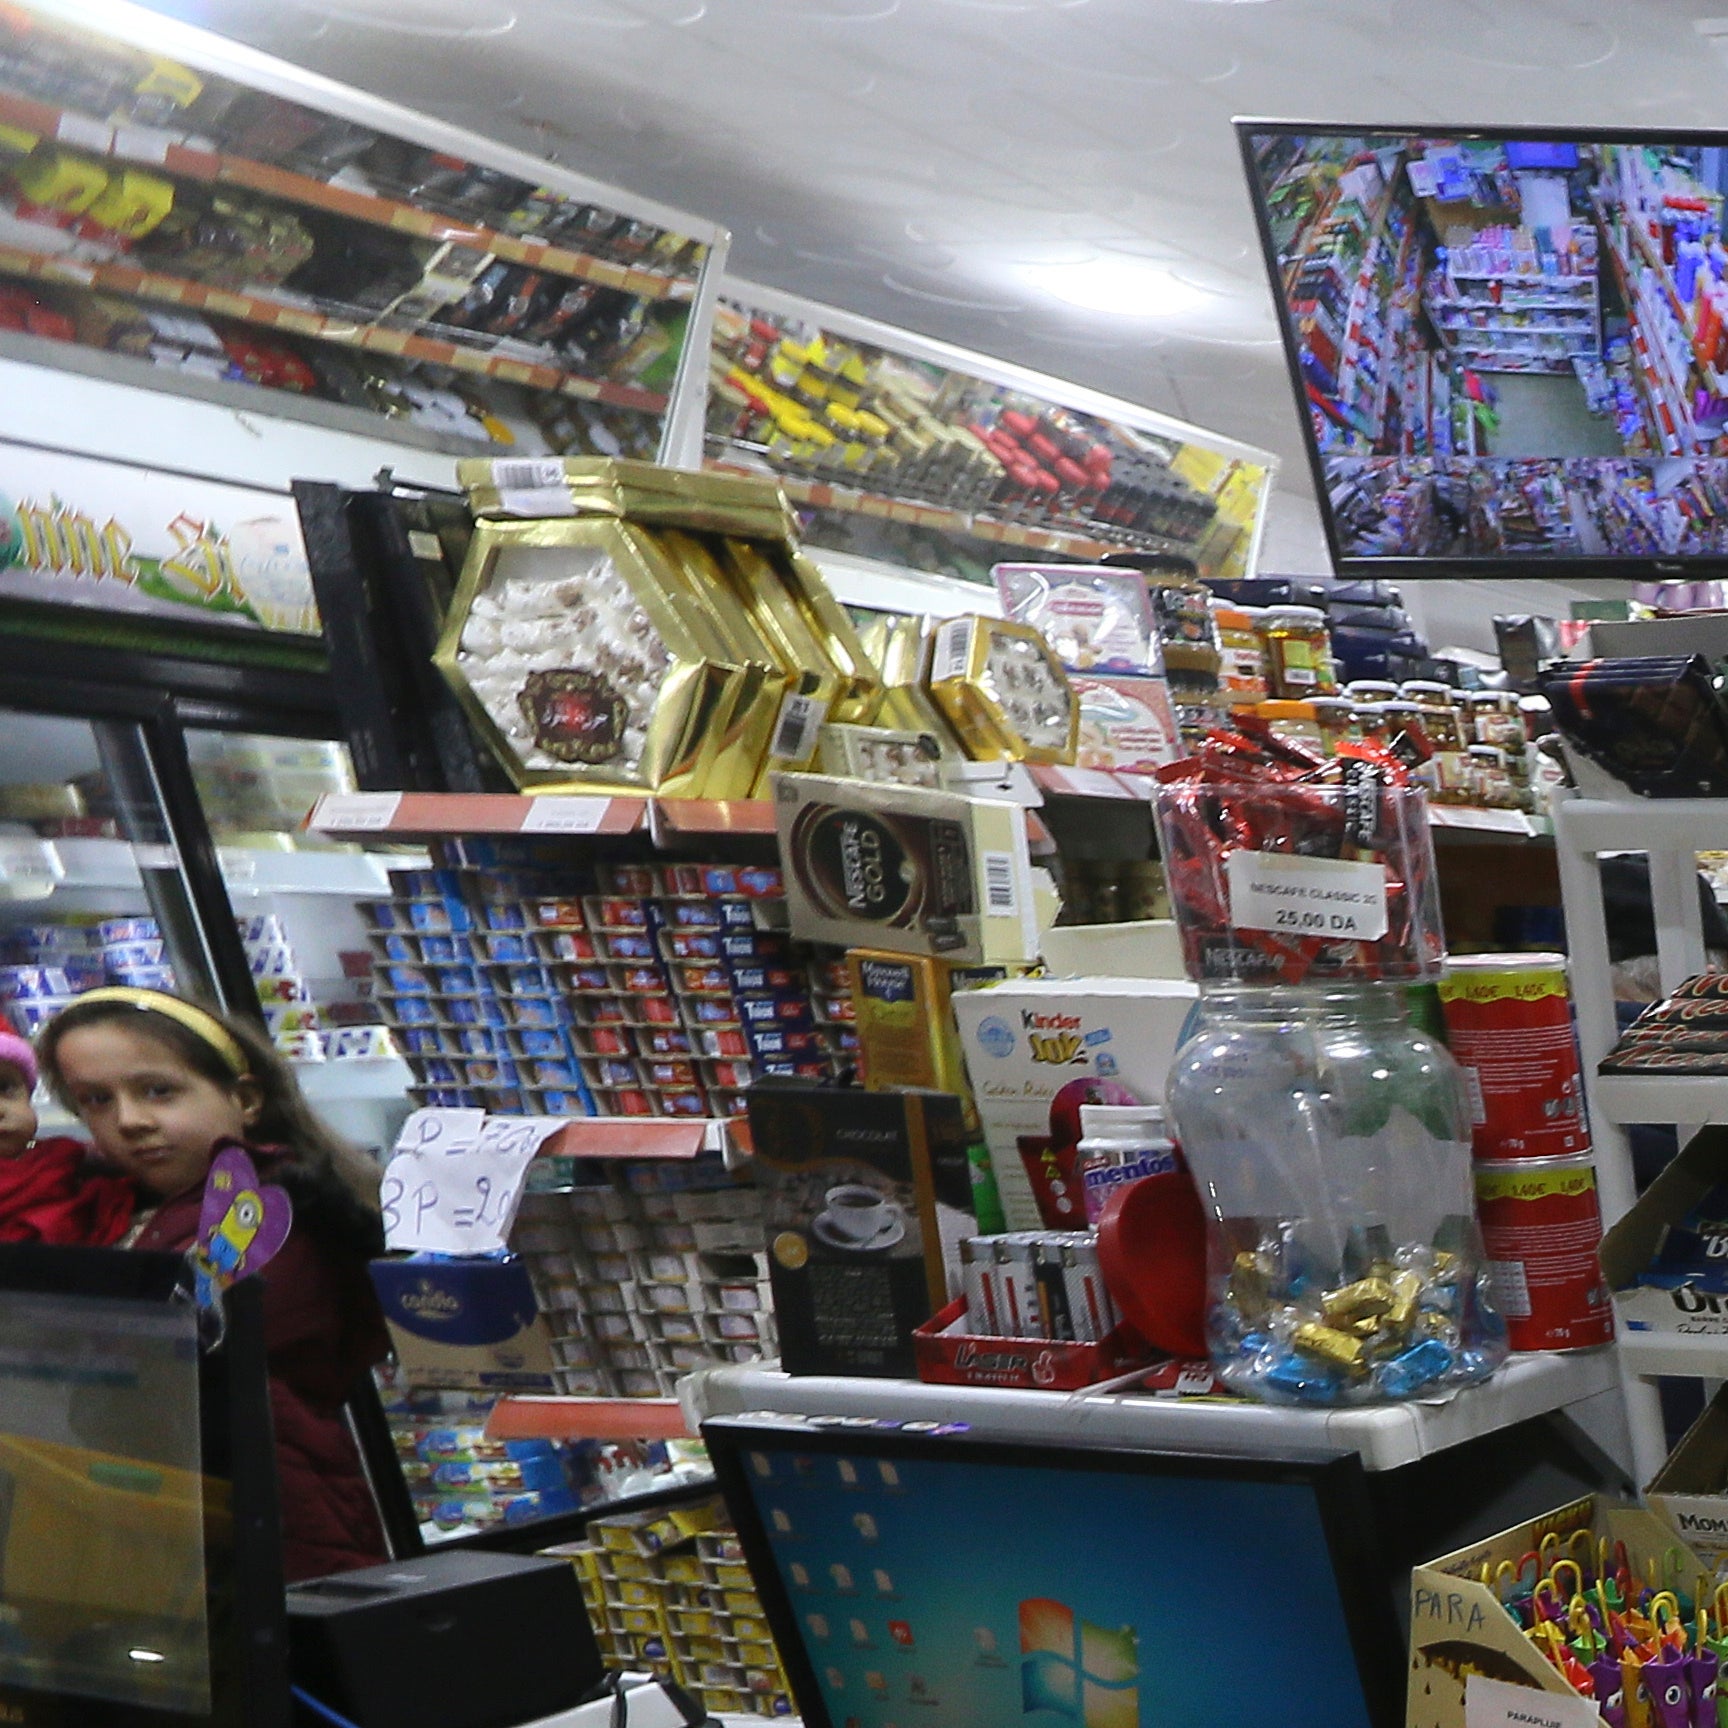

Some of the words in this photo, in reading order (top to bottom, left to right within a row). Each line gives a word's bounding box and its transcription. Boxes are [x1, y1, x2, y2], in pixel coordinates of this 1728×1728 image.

[860, 829, 886, 903] GOLD
[1308, 886, 1362, 904] CLASSIC
[1329, 912, 1359, 932] DA
[1020, 1008, 1082, 1030] Kinder
[1083, 1154, 1174, 1189] mentos
[1414, 1588, 1486, 1633] PARA
